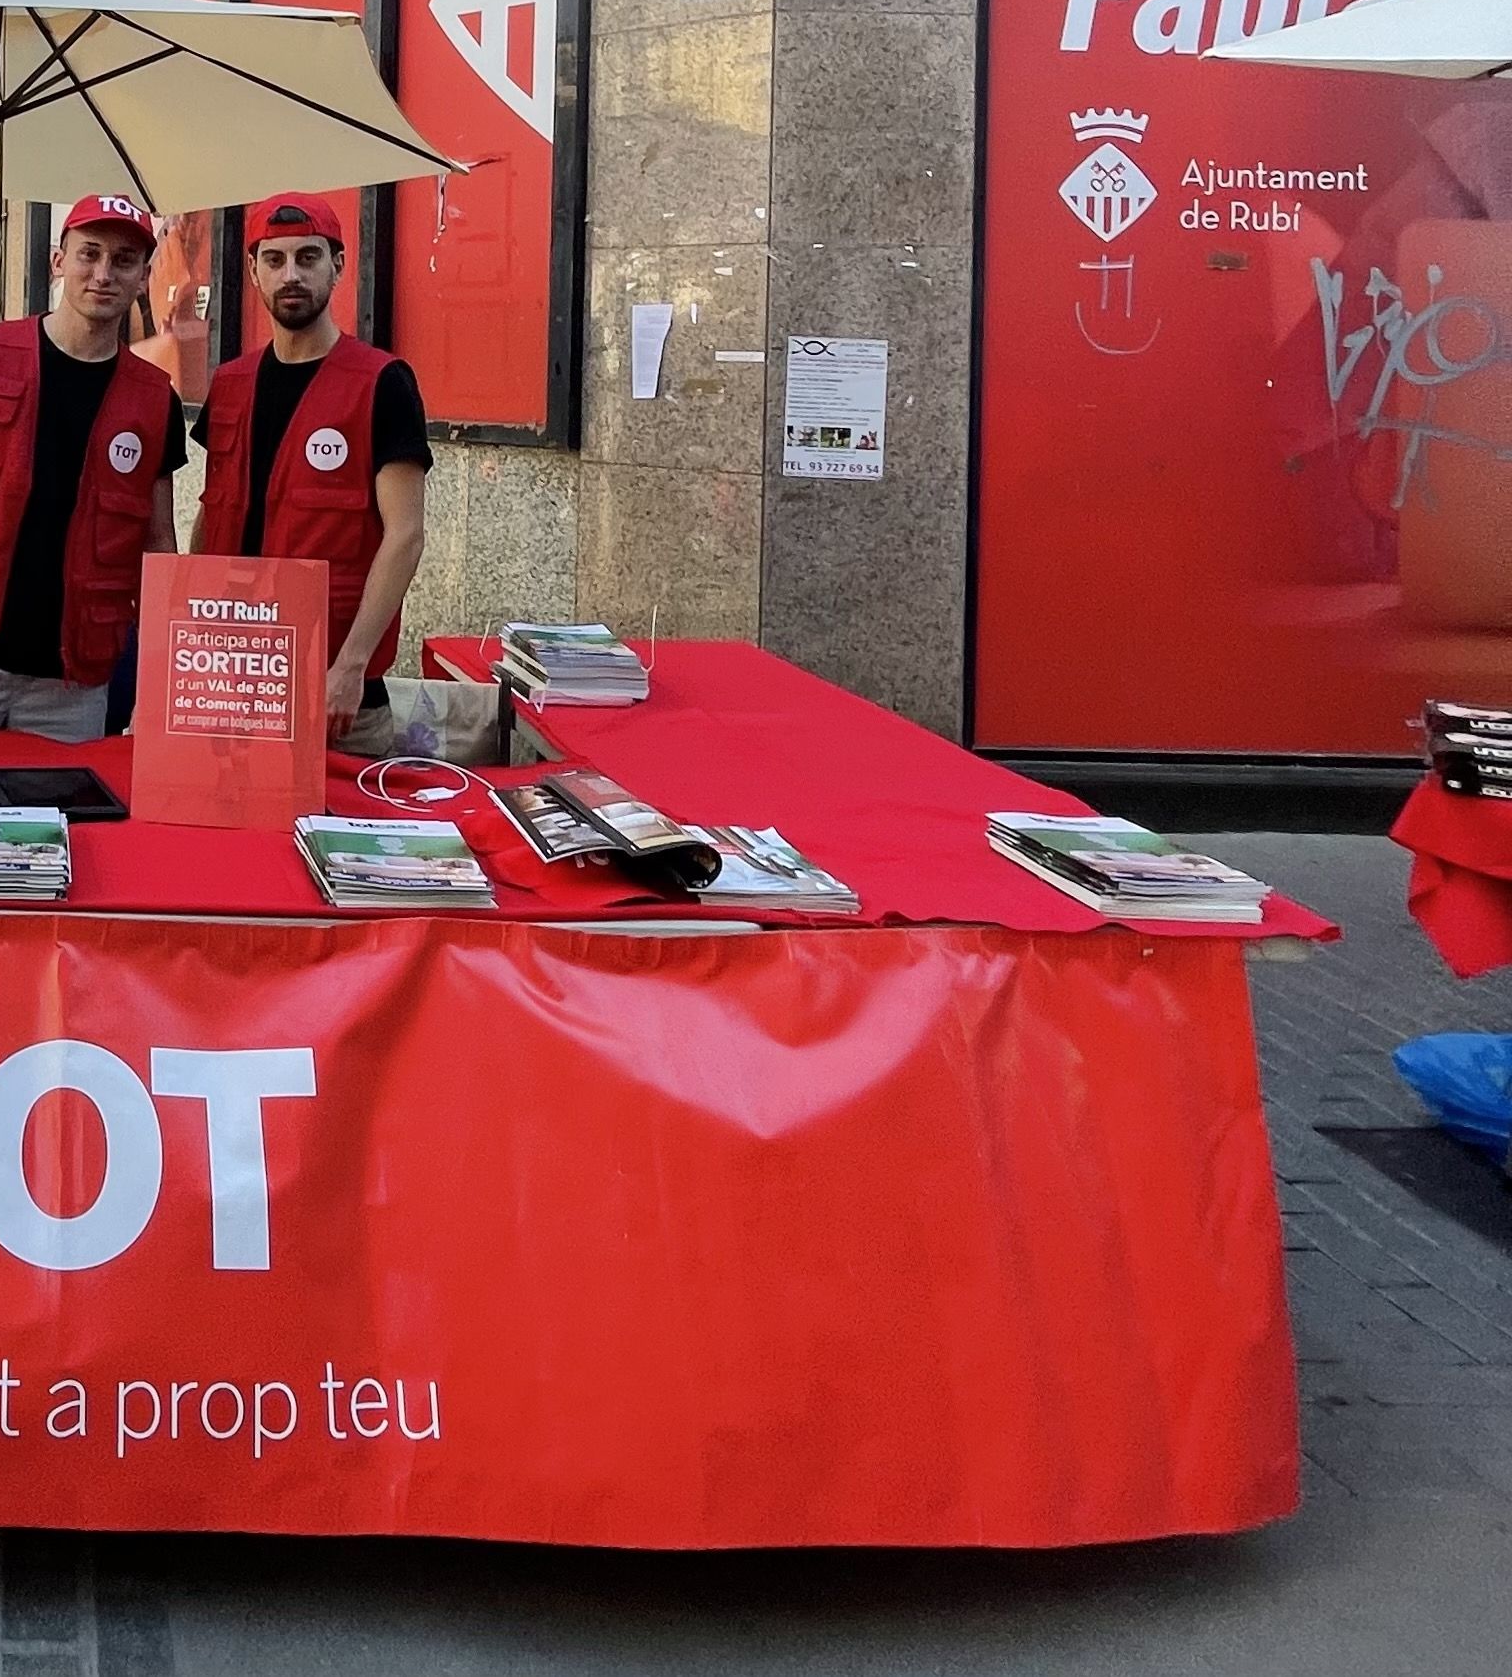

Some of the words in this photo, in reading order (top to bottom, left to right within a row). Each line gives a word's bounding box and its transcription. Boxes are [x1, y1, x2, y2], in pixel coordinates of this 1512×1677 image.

[1181, 158, 1369, 196] Ajuntament
[98, 196, 143, 222] TOT
[1179, 198, 1220, 229] de
[1230, 200, 1302, 232] Rubí
[114, 444, 138, 461] TOT
[311, 443, 343, 456] TOT
[809, 461, 823, 471] 93
[826, 463, 847, 473] 727
[849, 464, 863, 473] 69
[188, 599, 233, 620] TOT
[234, 602, 279, 621] Rubí
[176, 629, 248, 650] Participa
[251, 636, 271, 649] en
[275, 635, 289, 650] el
[175, 649, 289, 678] SORTEIG
[207, 679, 234, 693] VAL
[236, 682, 255, 694] de
[257, 682, 287, 696] 50€
[175, 696, 193, 709] de
[195, 697, 251, 714] Comerç
[253, 700, 287, 714] Rubí
[47, 1379, 87, 1436] a
[116, 1380, 298, 1459] prop
[321, 1361, 442, 1441] teu
